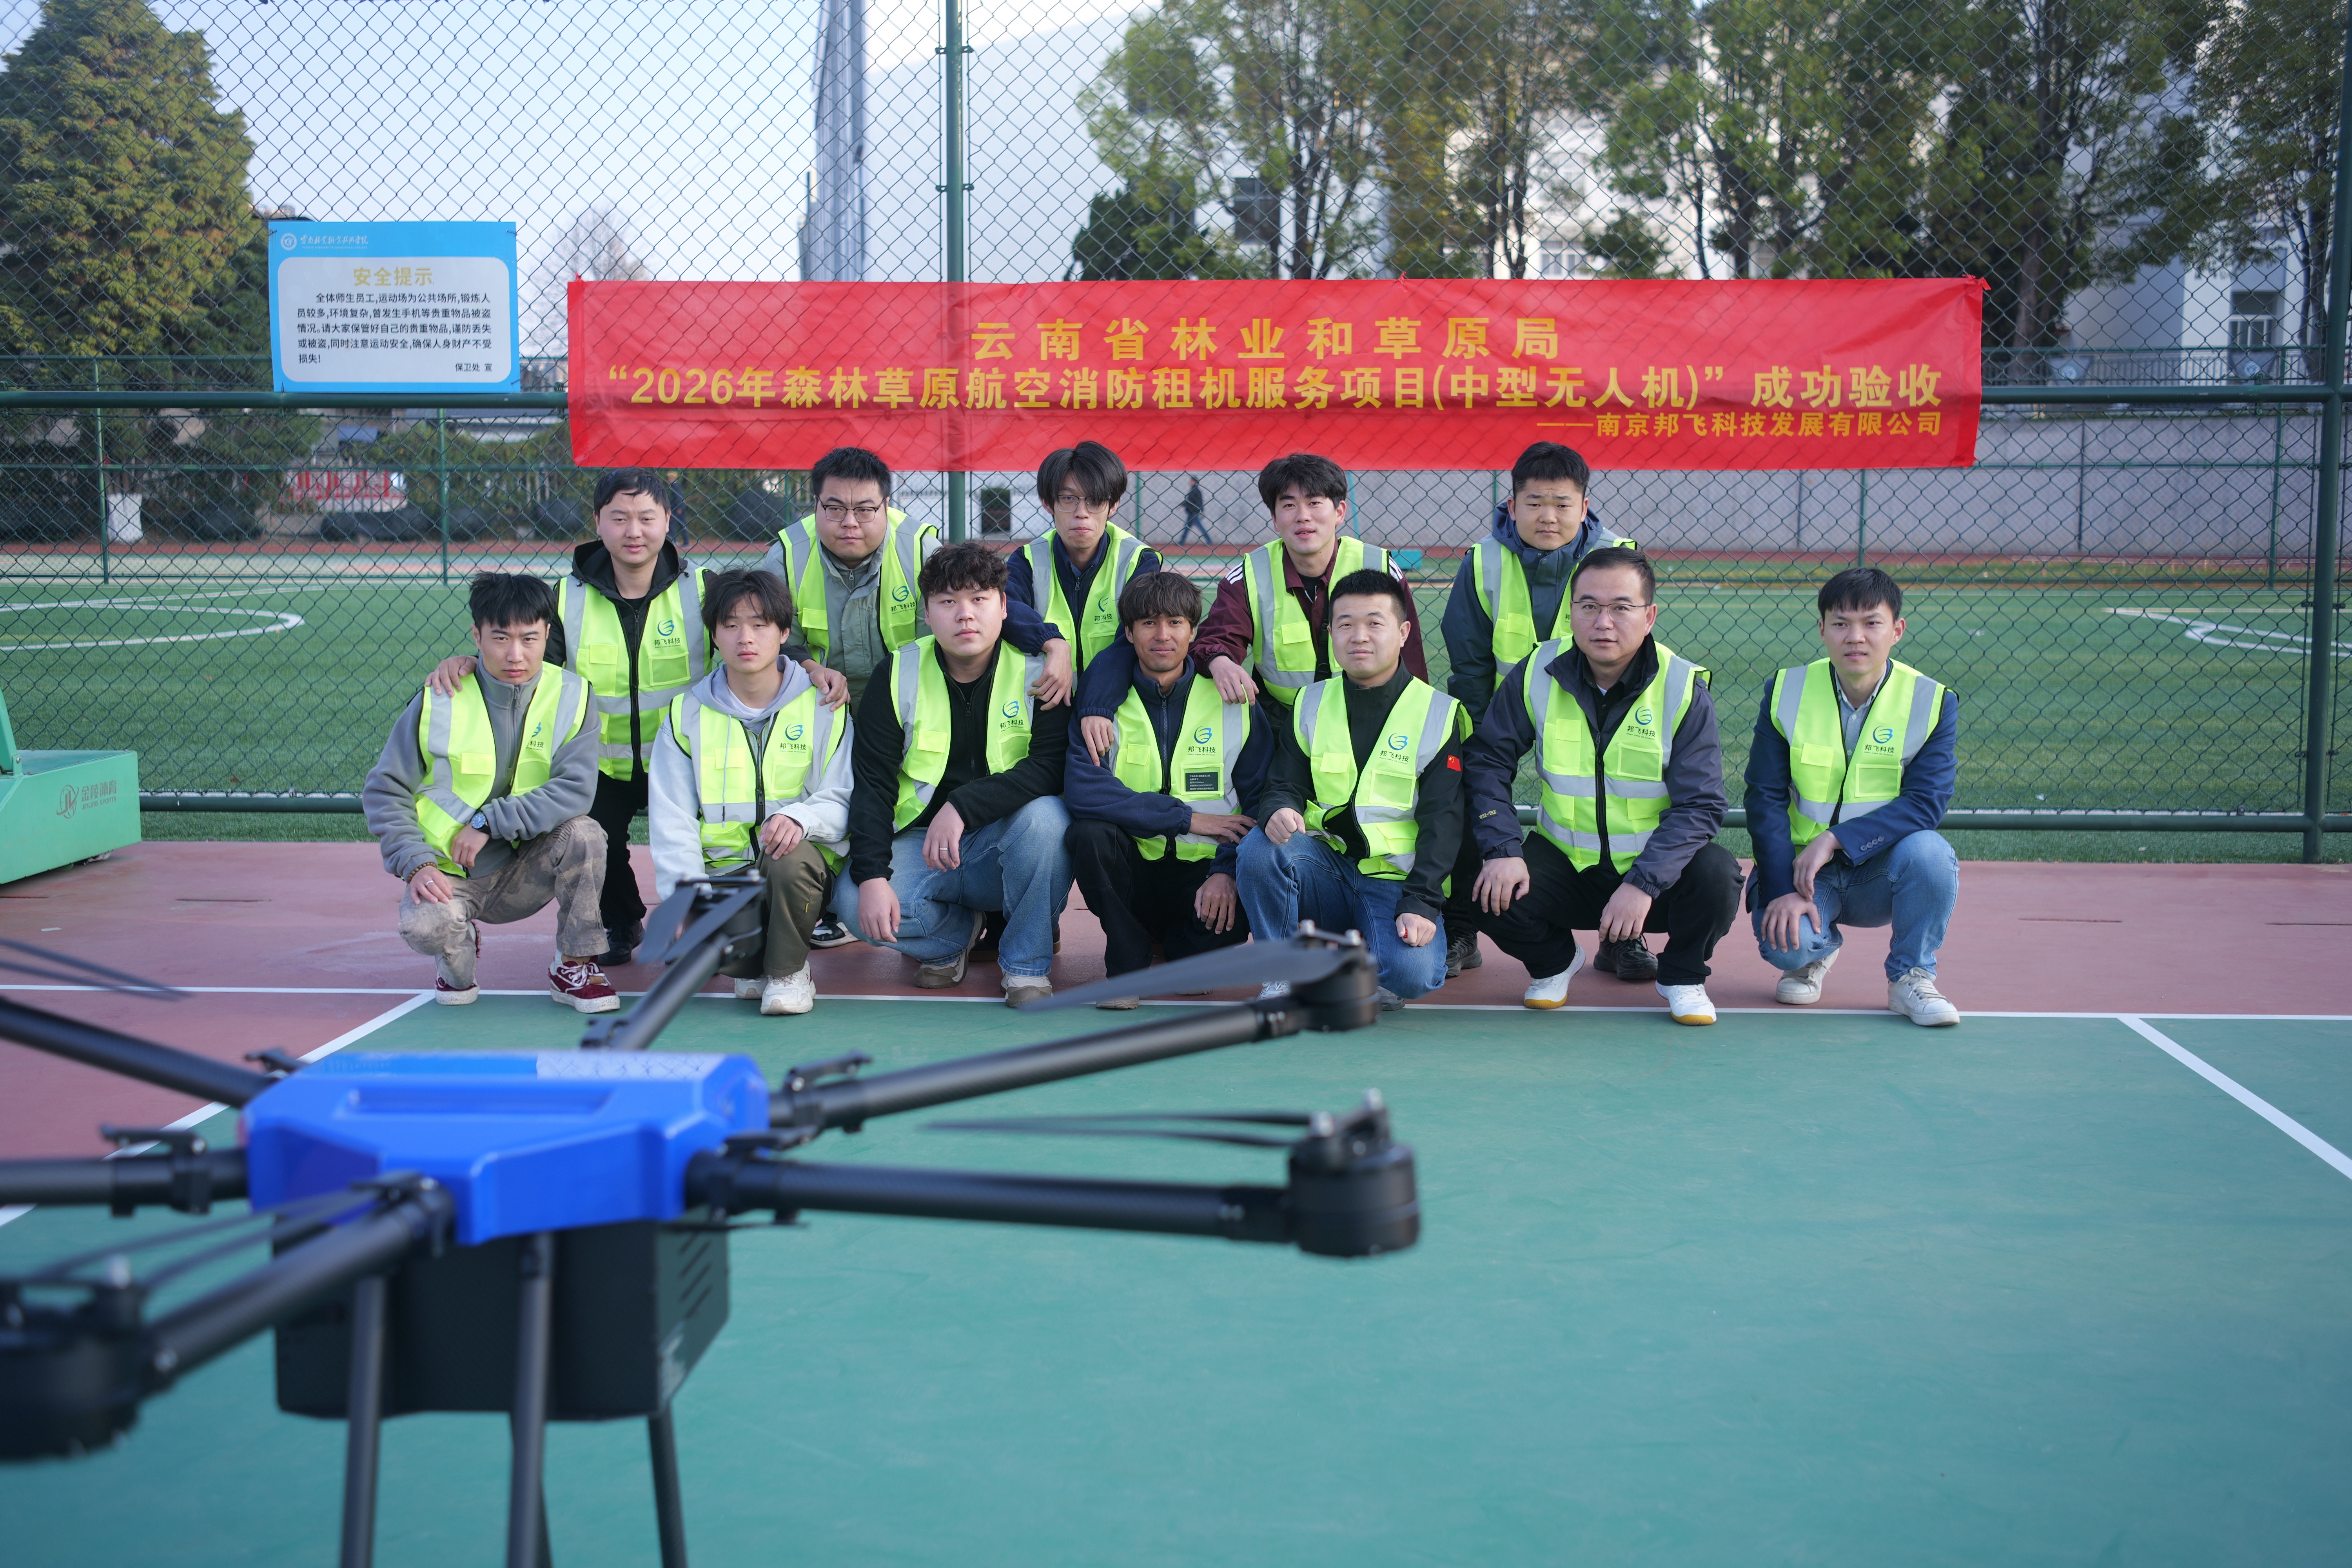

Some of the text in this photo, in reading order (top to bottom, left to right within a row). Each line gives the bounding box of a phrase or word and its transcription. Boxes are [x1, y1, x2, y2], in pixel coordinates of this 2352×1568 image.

[354, 266, 432, 287] 安全提示
[971, 317, 1558, 361] 云南省林业和草原局
[299, 353, 321, 364] 损失!
[455, 362, 492, 372] 保卫处 宣
[1750, 363, 1942, 408] 成功验收
[654, 637, 681, 646] 邦飞科技
[1000, 719, 1024, 729] 邦飞科技
[1627, 725, 1655, 737] 邦飞科技
[1865, 744, 1895, 753] 邦飞科技
[1380, 750, 1409, 762] 邦飞科技
[81, 780, 117, 802] 金陵体育
[82, 796, 117, 810] JINLING SPORTS
